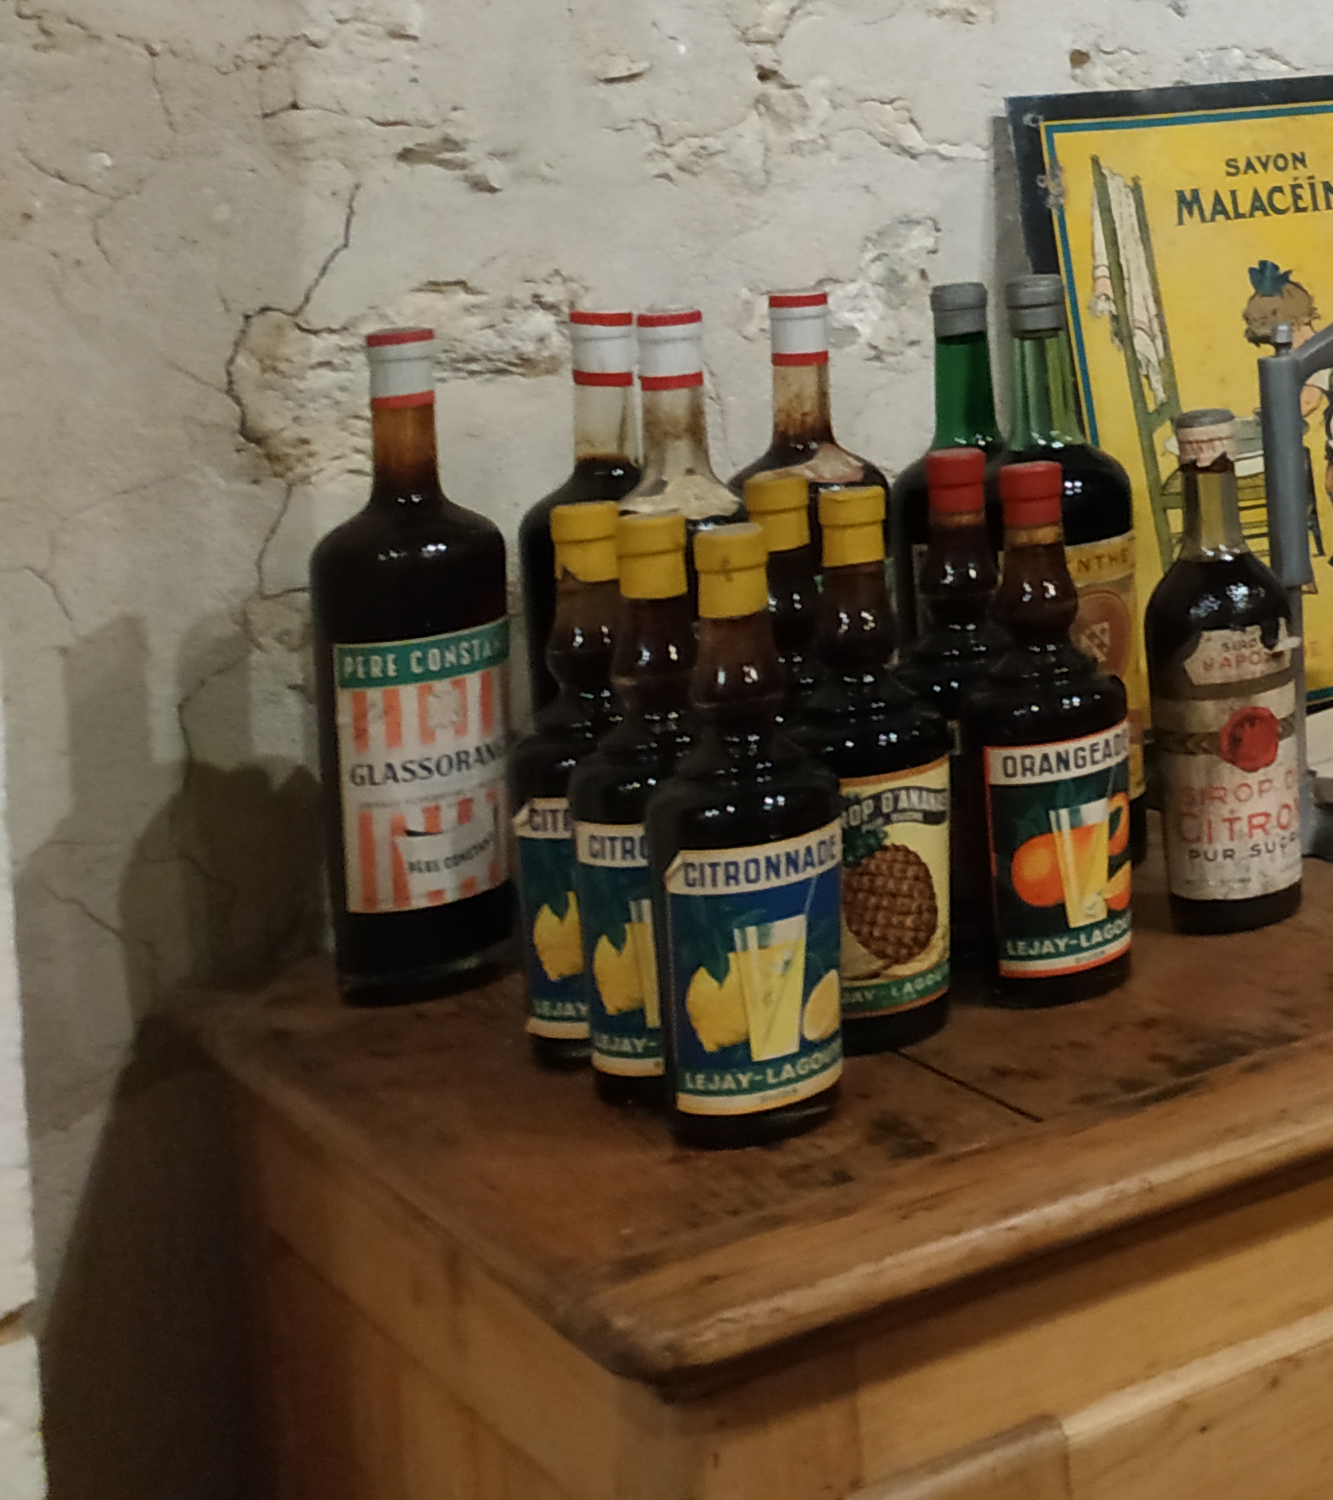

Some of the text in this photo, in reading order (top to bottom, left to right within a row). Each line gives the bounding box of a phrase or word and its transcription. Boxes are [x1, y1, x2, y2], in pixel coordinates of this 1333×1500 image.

[1223, 150, 1310, 178] SAVON
[1180, 778, 1274, 807] SIROP
[1178, 800, 1298, 845] CITRO
[684, 833, 839, 889] CITRONNADE
[1188, 848, 1236, 862] PUR
